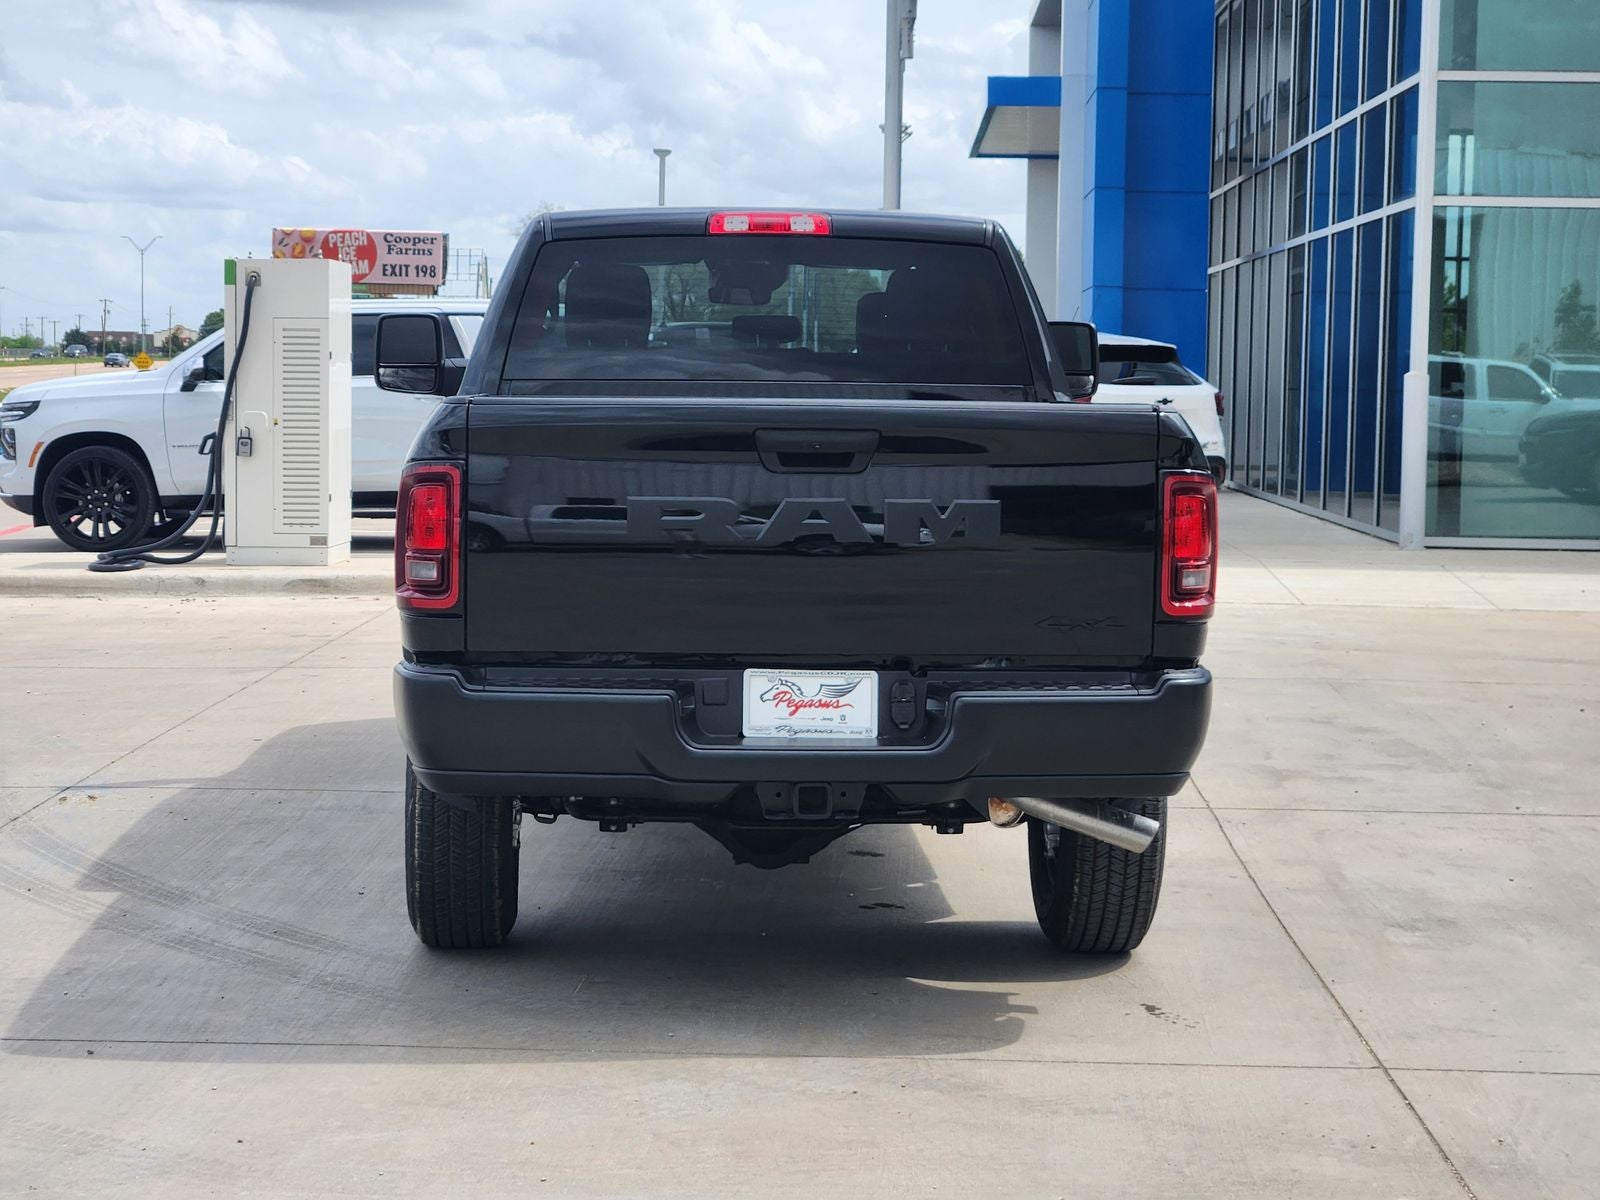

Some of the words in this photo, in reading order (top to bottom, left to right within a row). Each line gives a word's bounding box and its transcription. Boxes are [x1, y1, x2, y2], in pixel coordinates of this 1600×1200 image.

[328, 232, 367, 248] PEACH
[383, 233, 437, 245] Cooper
[338, 247, 357, 260] ICE
[386, 245, 433, 256] Farms
[382, 264, 409, 277] EXIT
[415, 265, 437, 278] 198
[626, 496, 1001, 546] RAM
[773, 690, 855, 717] Pegasus
[775, 725, 847, 736] Pegasus
